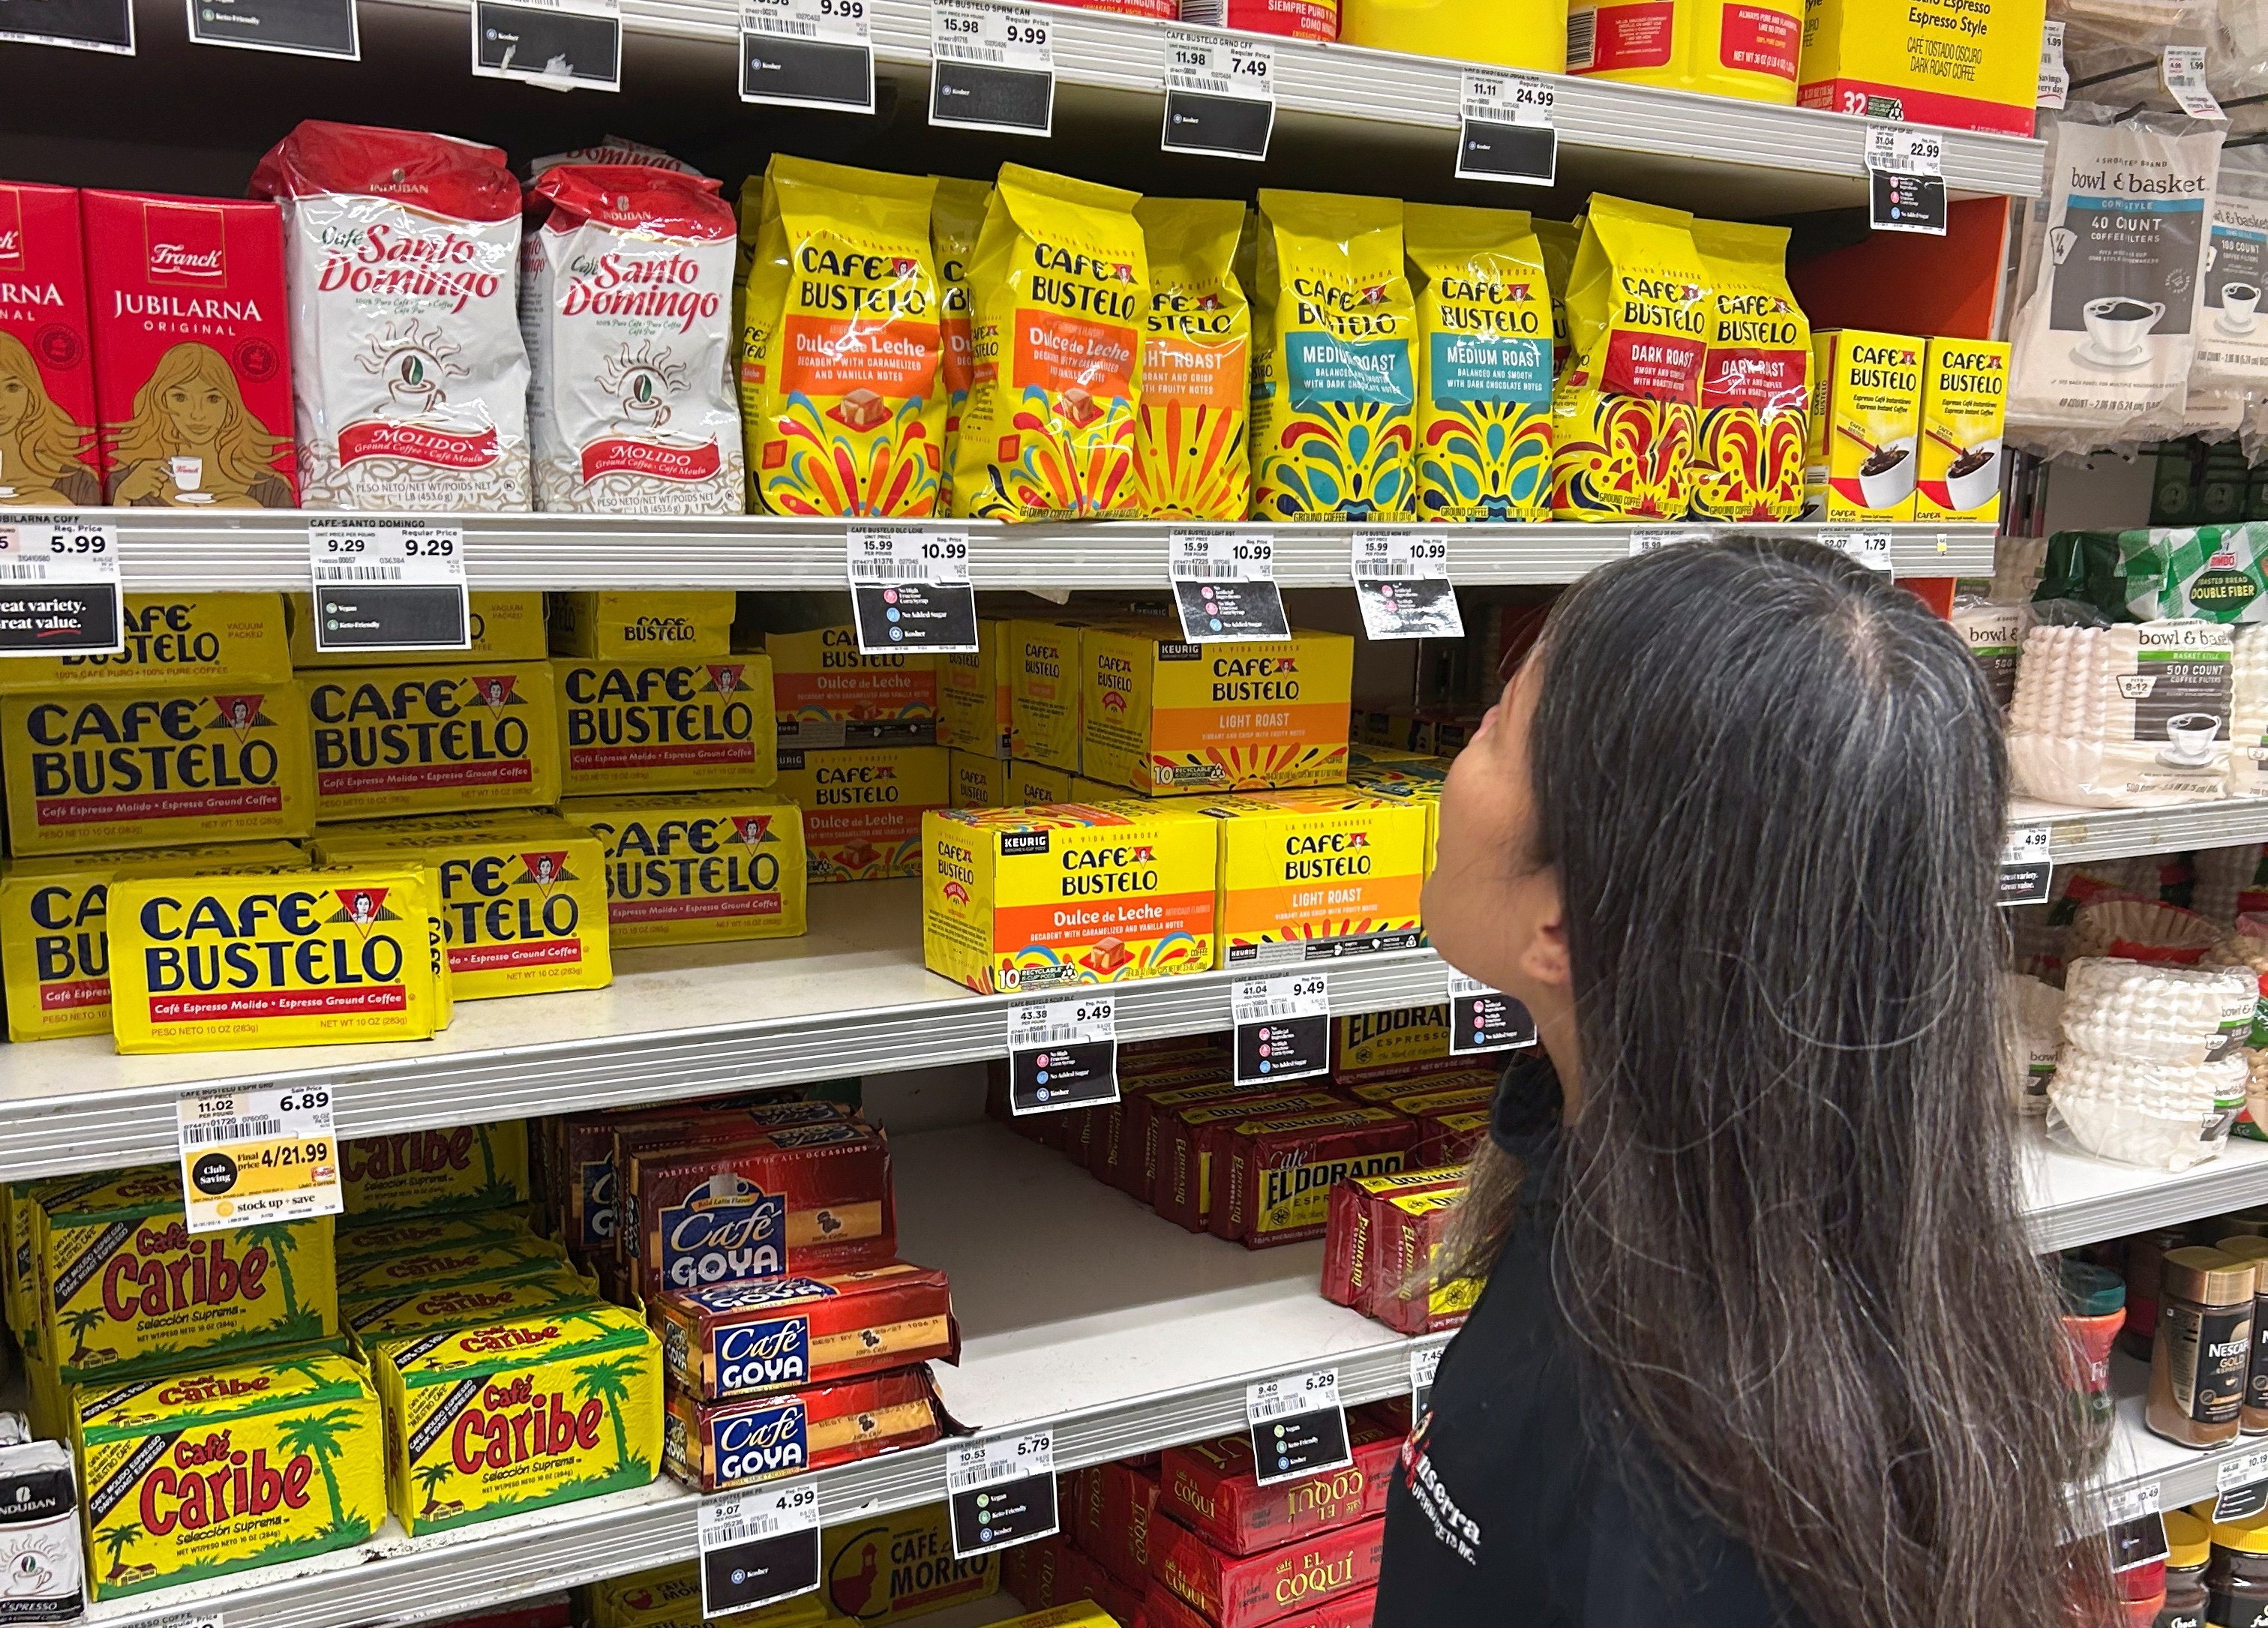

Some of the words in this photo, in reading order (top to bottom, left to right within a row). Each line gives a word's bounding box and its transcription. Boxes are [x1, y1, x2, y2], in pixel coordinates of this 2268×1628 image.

[944, 18, 979, 33] 15.98
[1006, 16, 1030, 24] Regular
[1909, 7, 1957, 29] Espresso
[1960, 16, 1988, 35] Style
[1007, 25, 1046, 44] 9.99
[1166, 31, 1184, 40] CAFE
[1186, 34, 1218, 45] BUSTELO
[2047, 37, 2061, 46] 1.99
[1176, 51, 1205, 65] 11.98
[1231, 49, 1253, 57] Regular
[1232, 58, 1267, 76] 7.49
[2190, 61, 2204, 70] 1.99
[1474, 83, 1496, 96] 11.11
[1516, 88, 1553, 106] 24.99
[1843, 91, 1866, 116] 32
[1875, 136, 1894, 145] 31.04
[1911, 143, 1939, 157] 22.99
[2072, 167, 2106, 190] bowl
[358, 224, 476, 263] Santo
[150, 244, 222, 268] Franck
[317, 249, 501, 315] Domingo
[114, 289, 263, 322] JUBILARNA
[800, 282, 926, 315] BUSTELO
[1031, 275, 1135, 319] BUSTELO
[562, 282, 721, 335] Domingo
[1442, 305, 1539, 334] BUSTELO
[1624, 302, 1705, 336] BUSTELO
[143, 321, 236, 337] ORIGINAL
[1717, 320, 1797, 345] BUSTELO
[868, 331, 926, 358] Leche
[1446, 346, 1497, 365] MEDIUM
[1502, 350, 1541, 368] ROAST
[1631, 345, 1664, 363] DARK
[1666, 347, 1694, 368] ROAST
[1457, 368, 1491, 378] BALANCED
[1492, 370, 1505, 379] AND
[1850, 368, 1916, 391] BUSTELO
[1940, 373, 2002, 394] BUSTELO
[610, 443, 691, 466] MOLIDO
[310, 519, 376, 528] CAFE-SANTO
[51, 535, 106, 553] 5.99
[328, 539, 364, 552] 9.29
[405, 539, 453, 556] 9.29
[864, 541, 892, 550] 15.99
[922, 544, 966, 559] 10.99
[1184, 543, 1208, 551] 15.99
[1233, 546, 1270, 559] 10.99
[1365, 543, 1388, 552] 15.99
[1410, 545, 1445, 558] 10.99
[1864, 539, 1886, 550] 1.79
[2192, 586, 2228, 600] DOUBLE
[2229, 584, 2254, 598] FIBER
[28, 599, 86, 613] variety.
[36, 616, 81, 628] value.
[2139, 631, 2180, 645] bowl
[2184, 631, 2195, 644] &
[1161, 644, 1199, 655] KEURIG
[2167, 664, 2188, 675] 500
[2193, 664, 2224, 674] COUNT
[565, 665, 704, 703] CAFÉ
[816, 676, 857, 689] Dulce
[860, 679, 871, 688] de
[872, 675, 911, 688] Leche
[1212, 680, 1299, 701] BUSTELO
[310, 677, 469, 723] CAFÉ
[27, 697, 208, 745] CAFÉ
[568, 702, 753, 747] BUSTELO
[1219, 713, 1250, 729] LIGHT
[1256, 712, 1289, 727] ROAST
[315, 716, 528, 769] BUSTELO
[33, 739, 278, 796] BUSTELO
[1154, 766, 1172, 784] 10
[816, 786, 898, 805] BUSTELO
[1004, 836, 1047, 848] KEURIG
[2026, 834, 2046, 845] 4.99
[1285, 855, 1371, 880] BUSTELO
[1061, 870, 1158, 896] BUSTELO
[1292, 892, 1324, 908] LIGHT
[1328, 887, 1363, 904] ROAST
[140, 891, 330, 942] CAFÉ
[1053, 908, 1100, 928] Dulce
[1102, 910, 1115, 922] de
[1118, 903, 1162, 921] Leche
[147, 935, 404, 993] BUSTELO
[998, 969, 1021, 989] 10
[1294, 981, 1324, 996] 9.49
[1244, 985, 1267, 994] 41.04
[154, 1003, 181, 1015] Café
[183, 1001, 228, 1014] Espresso
[231, 998, 268, 1011] Molido
[278, 997, 322, 1010] Espresso
[325, 994, 366, 1007] Ground
[368, 992, 402, 1004] Coffee
[1077, 1005, 1111, 1021] 9.49
[1020, 1010, 1047, 1020] 43.38
[199, 1100, 234, 1113] 11.02
[280, 1092, 328, 1111] 6.89
[237, 1152, 259, 1162] Final
[262, 1142, 327, 1168] 4/21.99
[658, 1165, 706, 1180] PERFECT
[781, 1152, 801, 1162] ALL
[806, 1144, 868, 1160] OCCASIONS
[200, 1174, 231, 1185] Saving
[203, 1165, 226, 1175] Club
[238, 1201, 266, 1213] stock
[268, 1200, 283, 1209] up
[292, 1195, 316, 1205] save
[670, 1207, 782, 1252] Café
[670, 1246, 780, 1288] GOYA
[102, 1237, 269, 1321] Caribe
[458, 1324, 562, 1353] Caribe
[723, 1325, 806, 1361] Café
[2220, 1354, 2245, 1368] GOLD
[720, 1354, 804, 1389] GOYA
[483, 1374, 534, 1410] Café
[1258, 1384, 1277, 1394] 9.40
[1306, 1375, 1334, 1390] 5.29
[452, 1391, 604, 1476] Caribe
[720, 1414, 803, 1452] Café
[174, 1429, 232, 1470] Café
[961, 1450, 986, 1462] 10.53
[1018, 1438, 1049, 1456] 5.79
[721, 1443, 802, 1480] GOYA
[140, 1448, 313, 1537] Caribe
[776, 1491, 814, 1510] 4.99
[716, 1505, 740, 1517] 9.07
[175, 1525, 231, 1546] Selección
[232, 1516, 283, 1534] Suprema
[1304, 1554, 1324, 1570] EL
